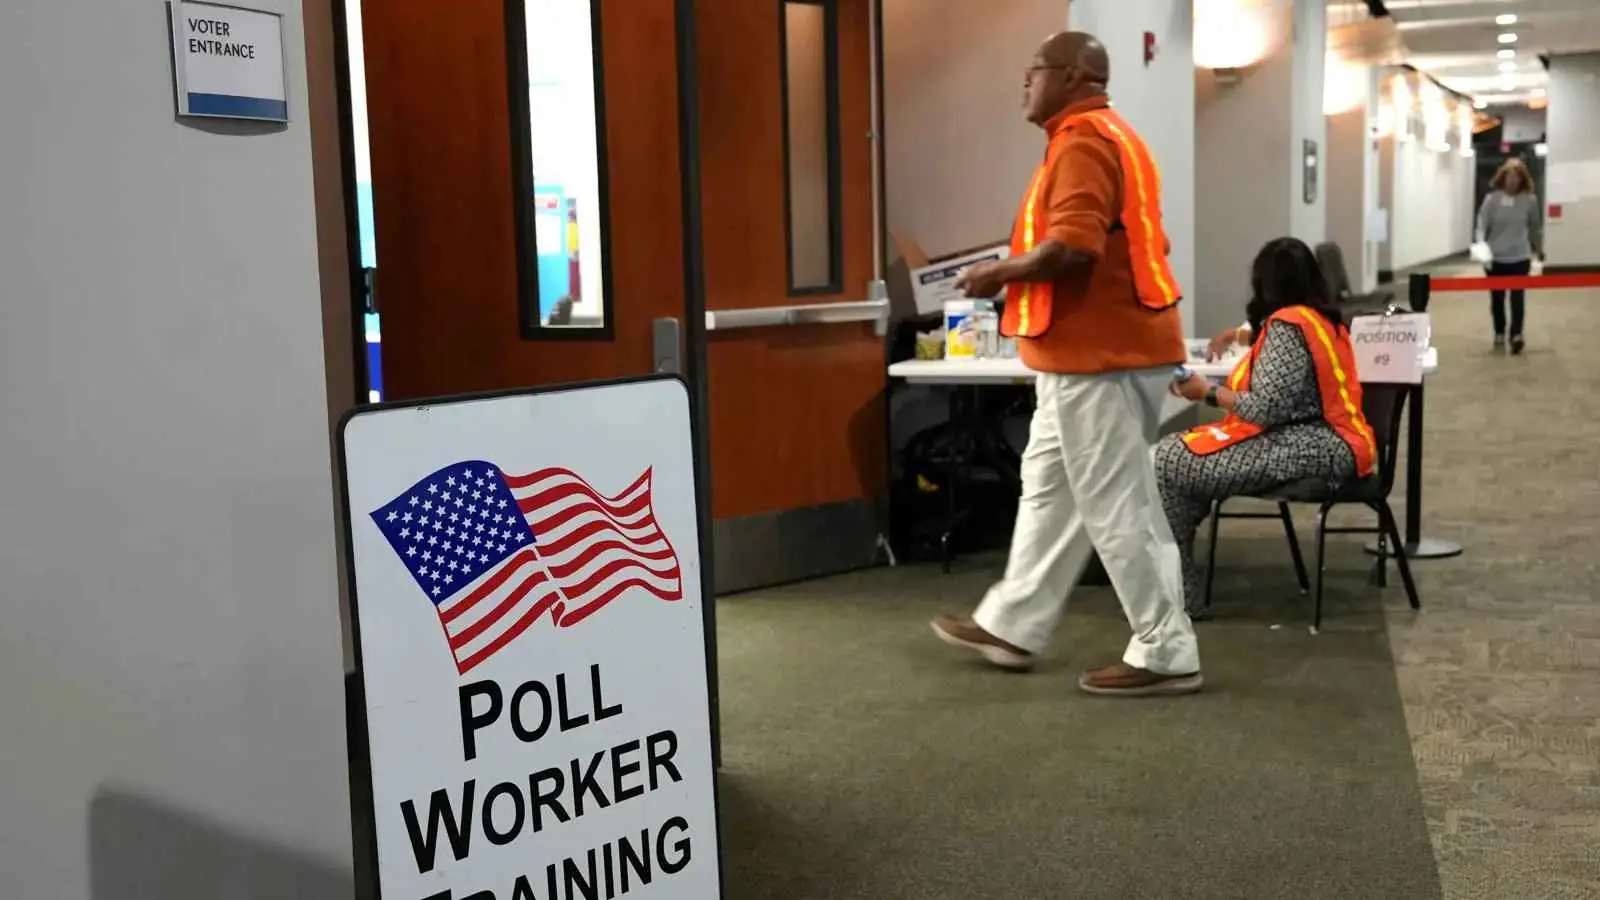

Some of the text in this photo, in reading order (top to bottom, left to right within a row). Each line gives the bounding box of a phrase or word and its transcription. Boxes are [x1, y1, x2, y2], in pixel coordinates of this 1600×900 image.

[188, 18, 230, 37] VOTER
[189, 38, 255, 59] ENTRANCE
[1356, 330, 1417, 344] POSITION
[459, 664, 622, 761] POLL
[400, 730, 682, 873] WORKER
[419, 816, 692, 900] INING
